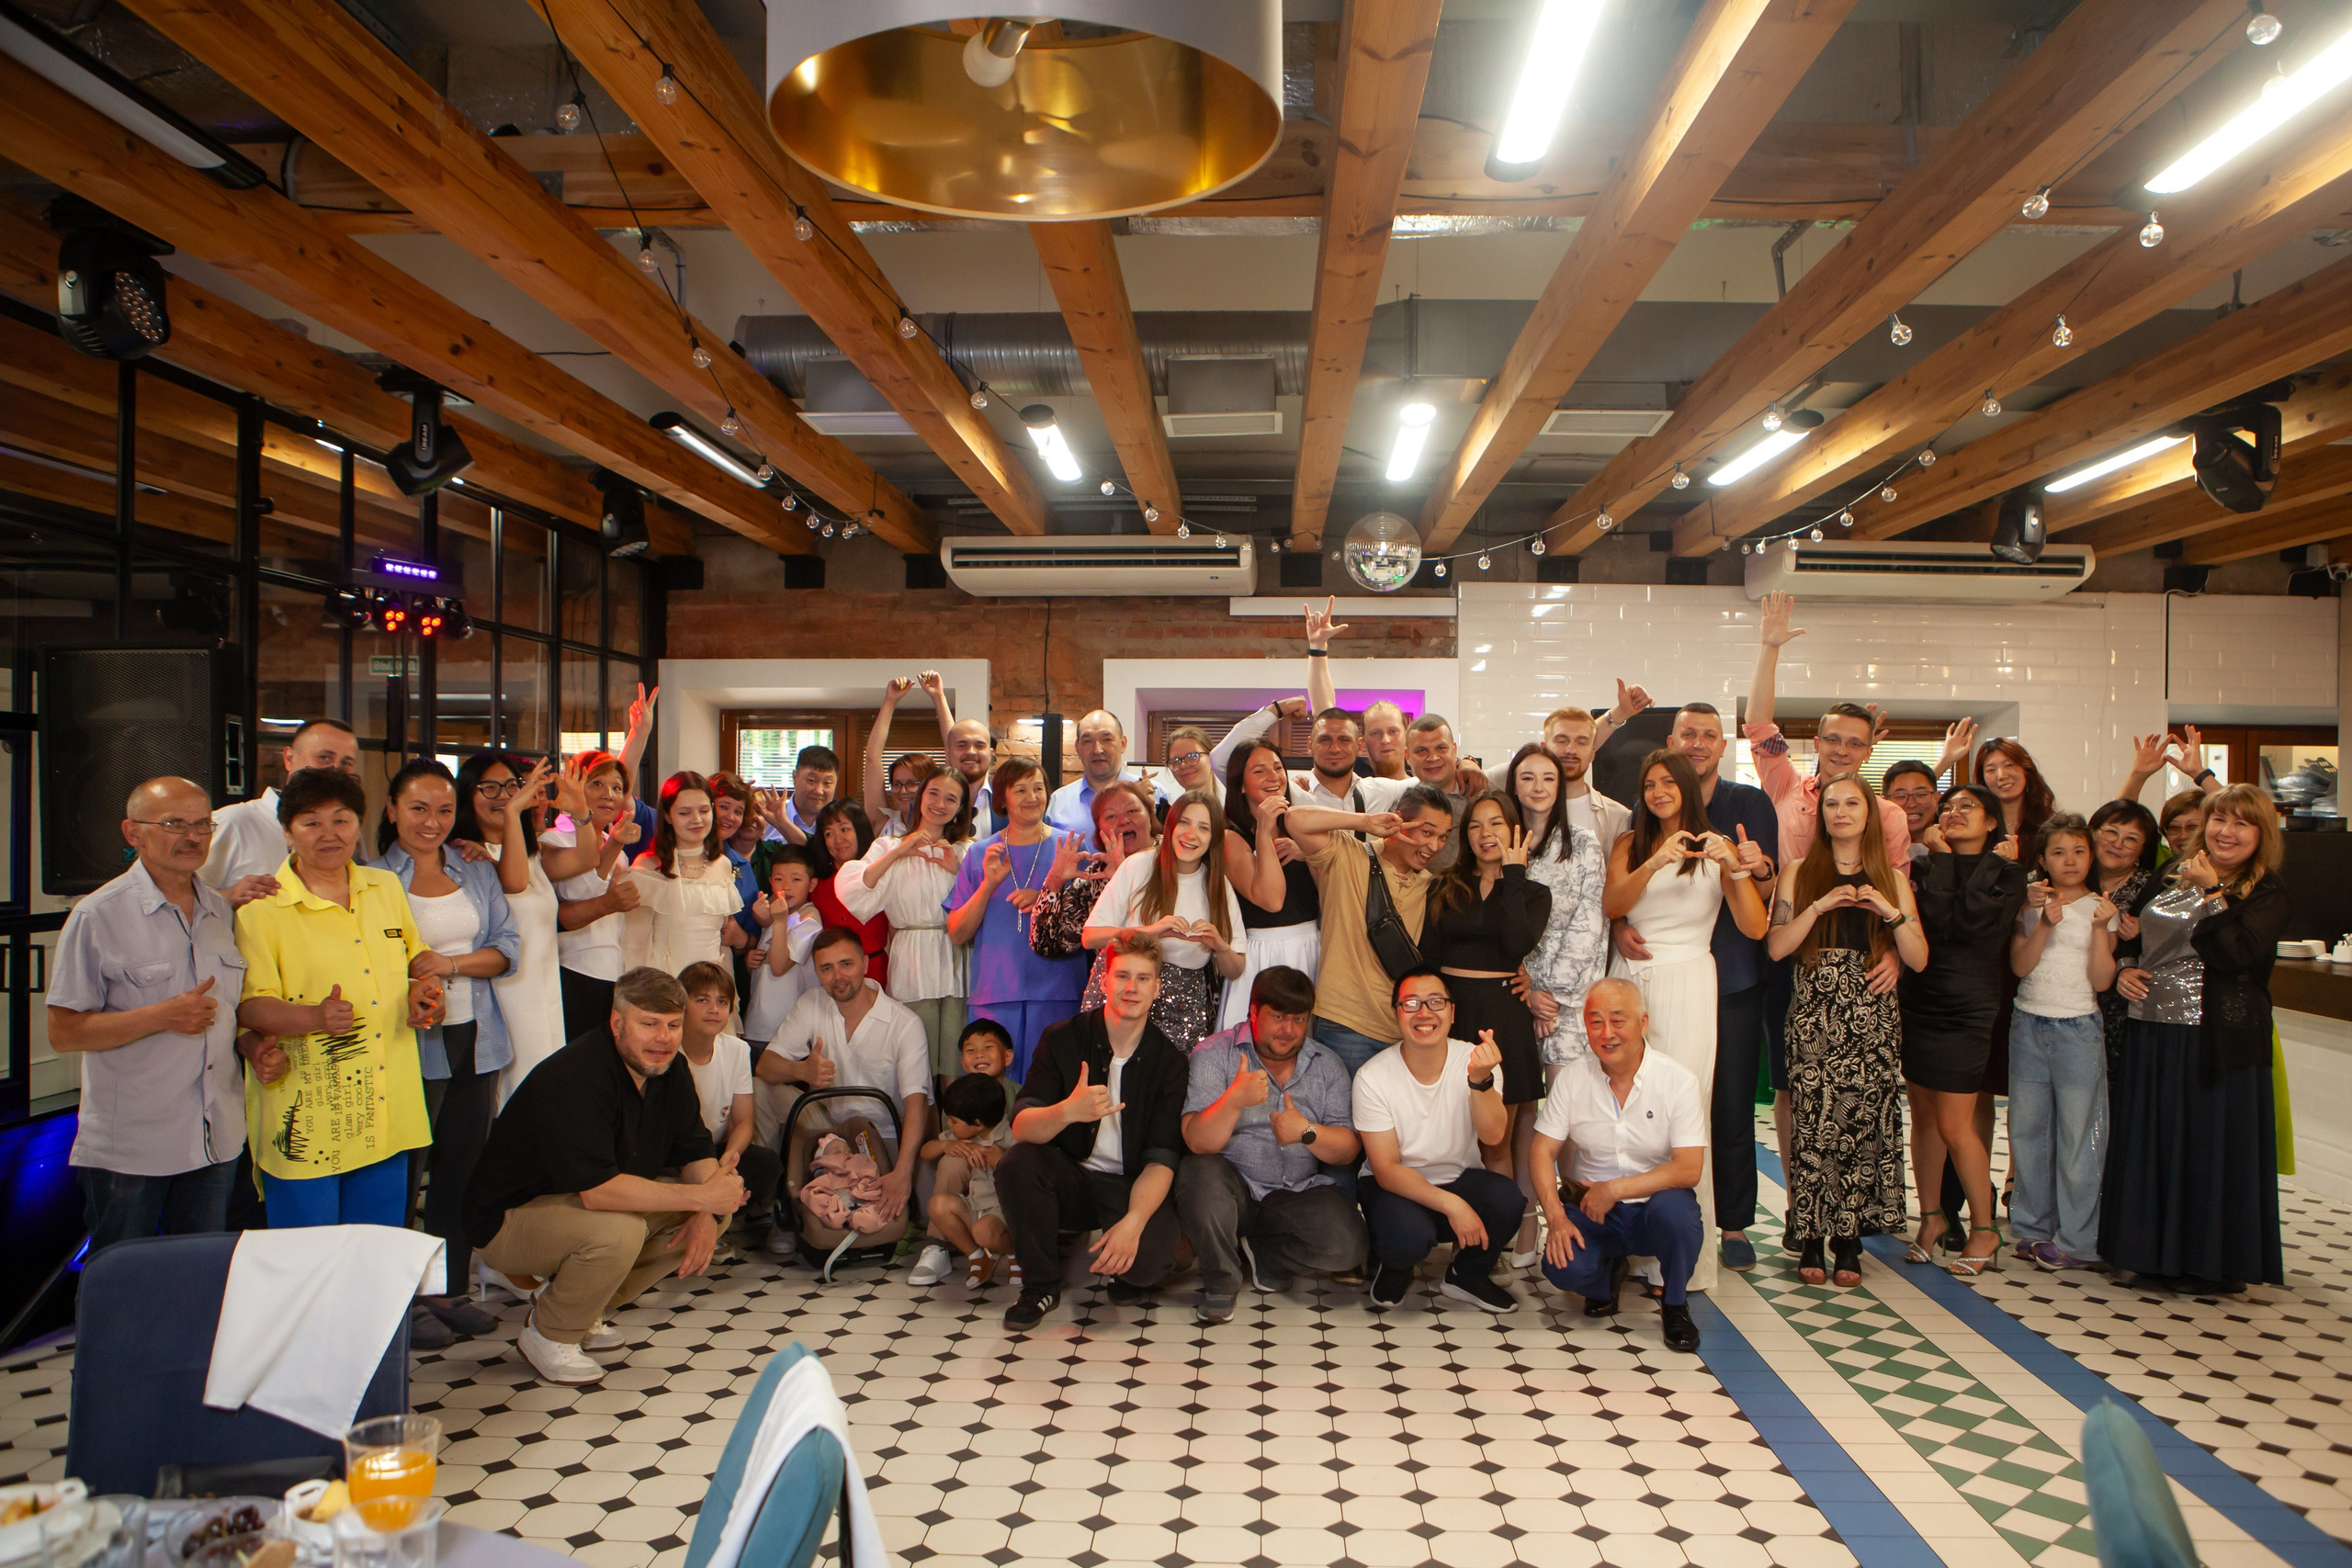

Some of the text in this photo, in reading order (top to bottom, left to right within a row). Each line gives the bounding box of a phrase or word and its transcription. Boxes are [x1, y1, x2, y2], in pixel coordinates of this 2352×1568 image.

[305, 1090, 313, 1109] ARE
[312, 1062, 324, 1107] glam girl
[306, 1115, 314, 1134] YOU
[342, 1083, 354, 1139] glam girl
[353, 1083, 366, 1136] very cool
[365, 1066, 376, 1149] IS FANTASTIC
[331, 1118, 341, 1142] ARE
[331, 1150, 341, 1172] YOU
